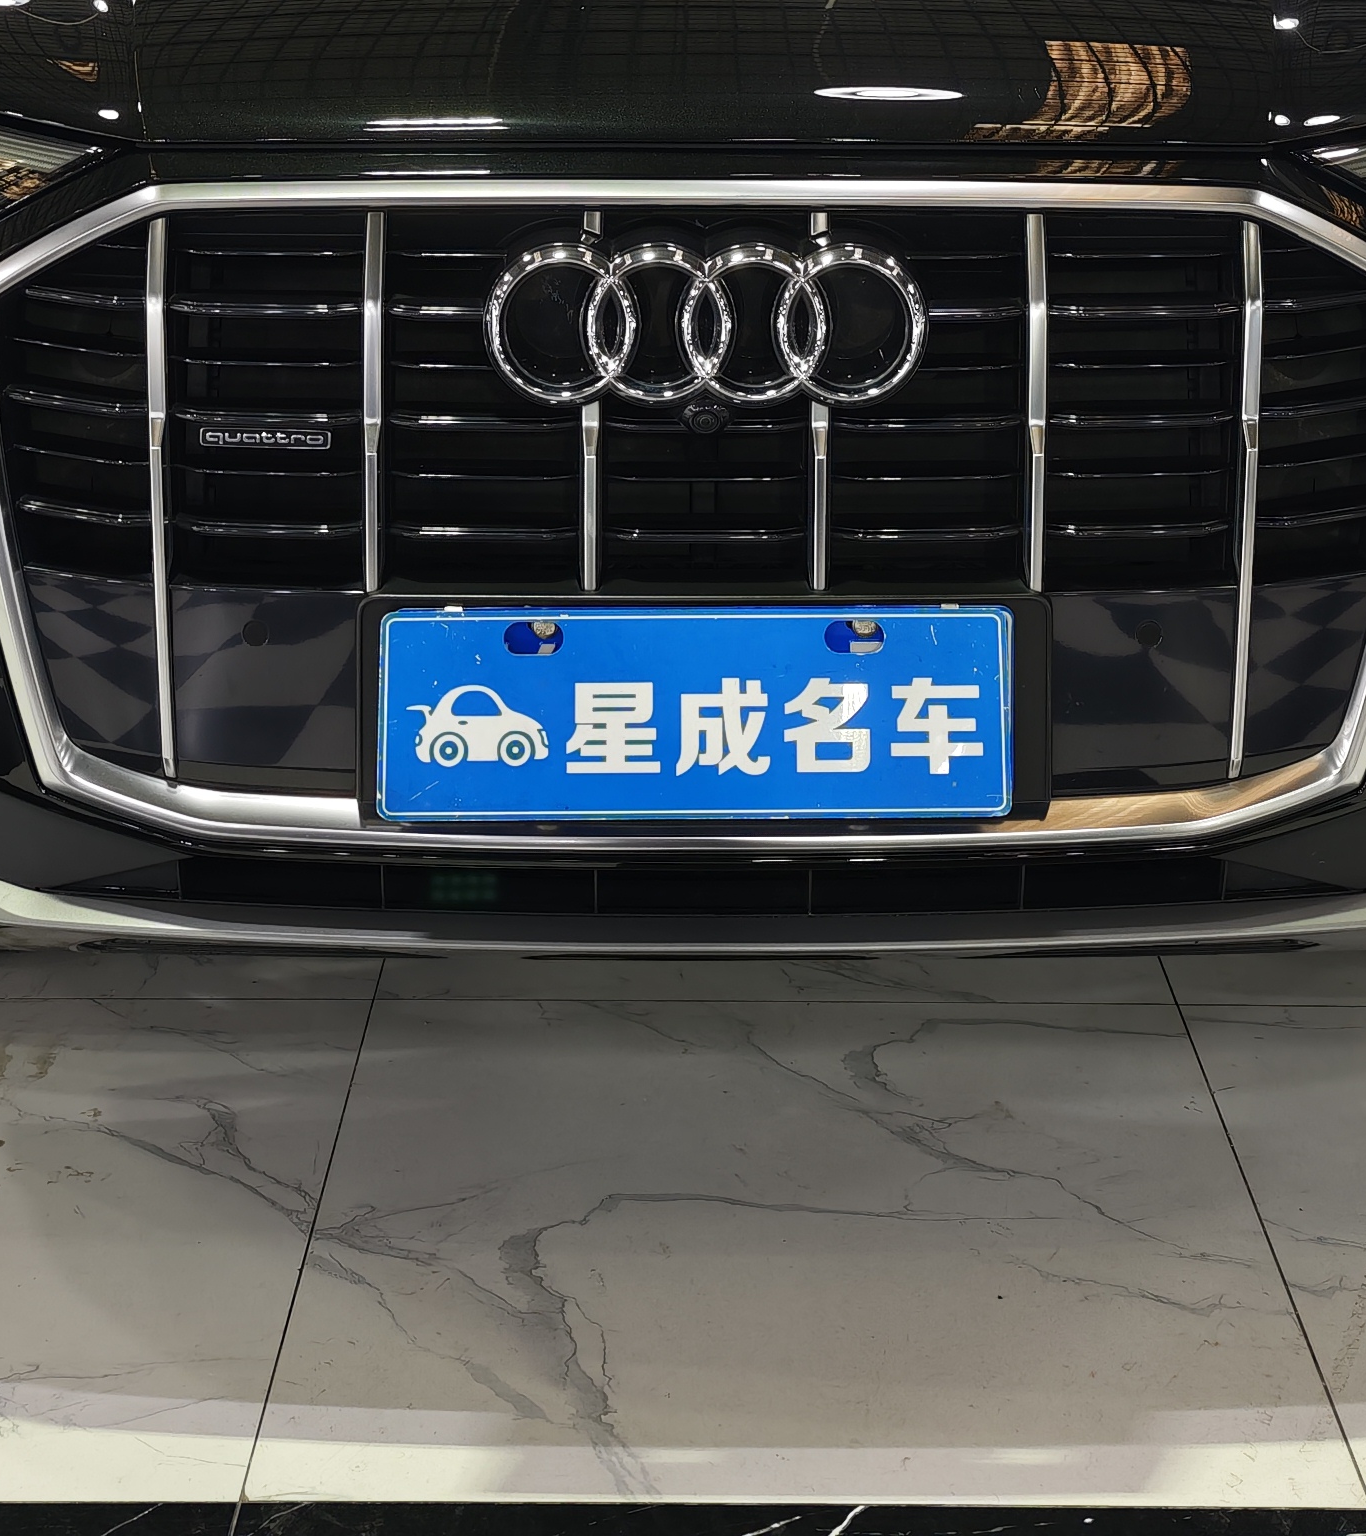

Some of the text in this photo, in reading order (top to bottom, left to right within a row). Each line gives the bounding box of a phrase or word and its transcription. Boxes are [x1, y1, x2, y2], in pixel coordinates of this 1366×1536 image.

[205, 431, 324, 445] quattro
[564, 675, 985, 778] 星成名车
